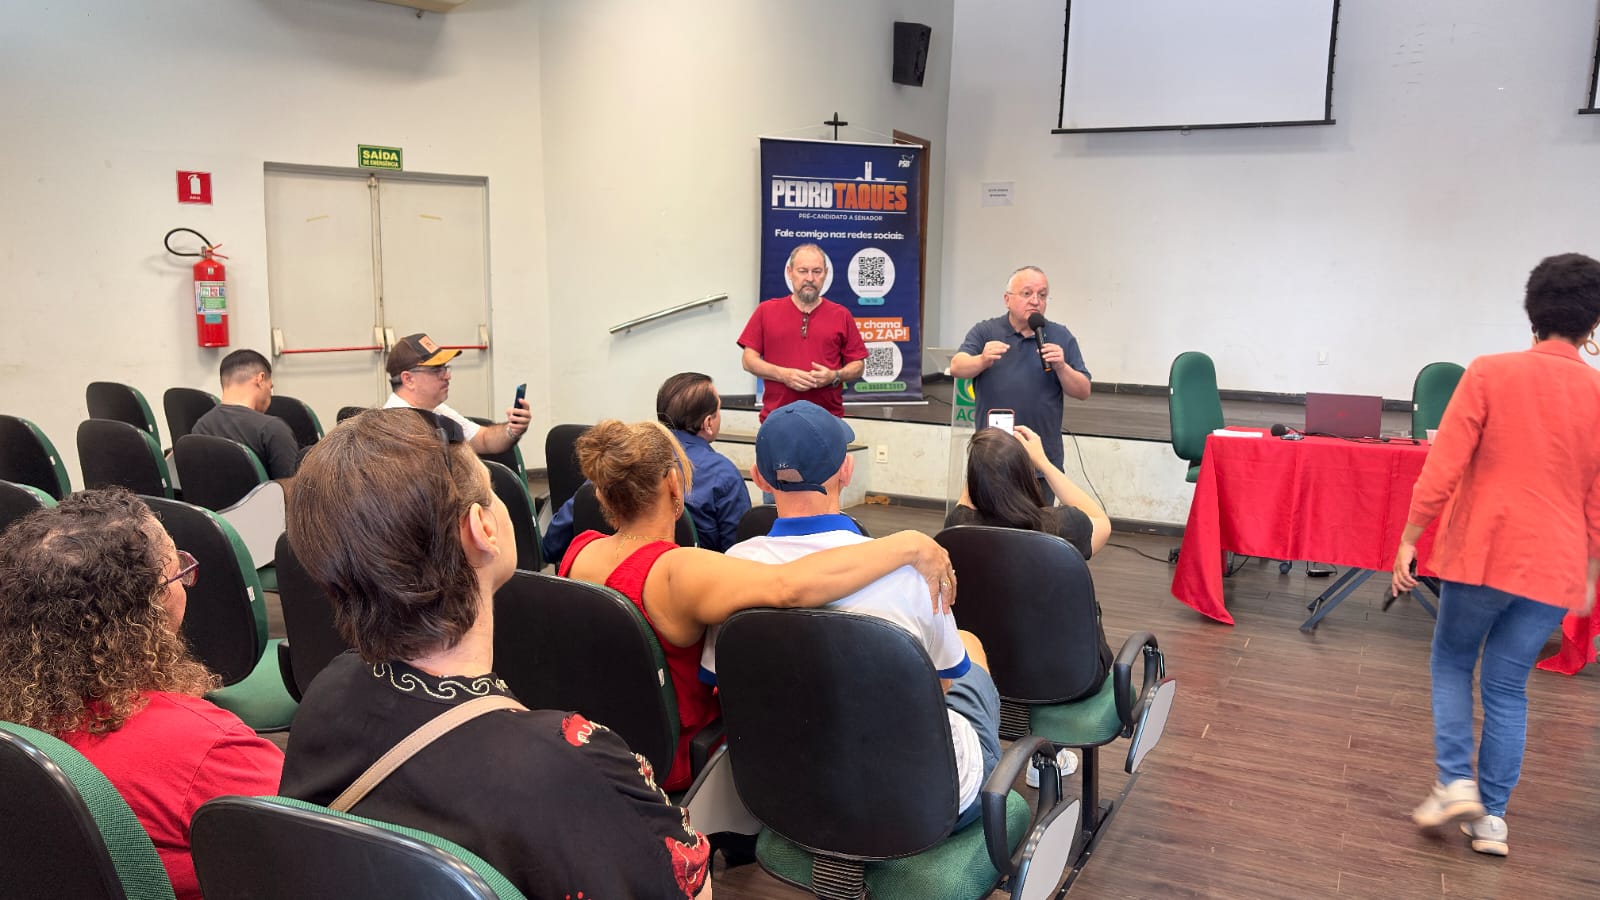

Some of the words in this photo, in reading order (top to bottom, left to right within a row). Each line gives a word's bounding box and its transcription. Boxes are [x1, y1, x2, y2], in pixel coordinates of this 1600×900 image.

[363, 150, 398, 161] SAÍDA
[772, 180, 833, 208] PEDRO
[834, 183, 908, 211] TAQUES
[775, 228, 794, 238] Fale
[796, 230, 829, 240] comigo
[847, 231, 872, 239] redes
[873, 232, 904, 240] sociais:
[864, 320, 900, 328] chama
[876, 328, 906, 340] ZAP!
